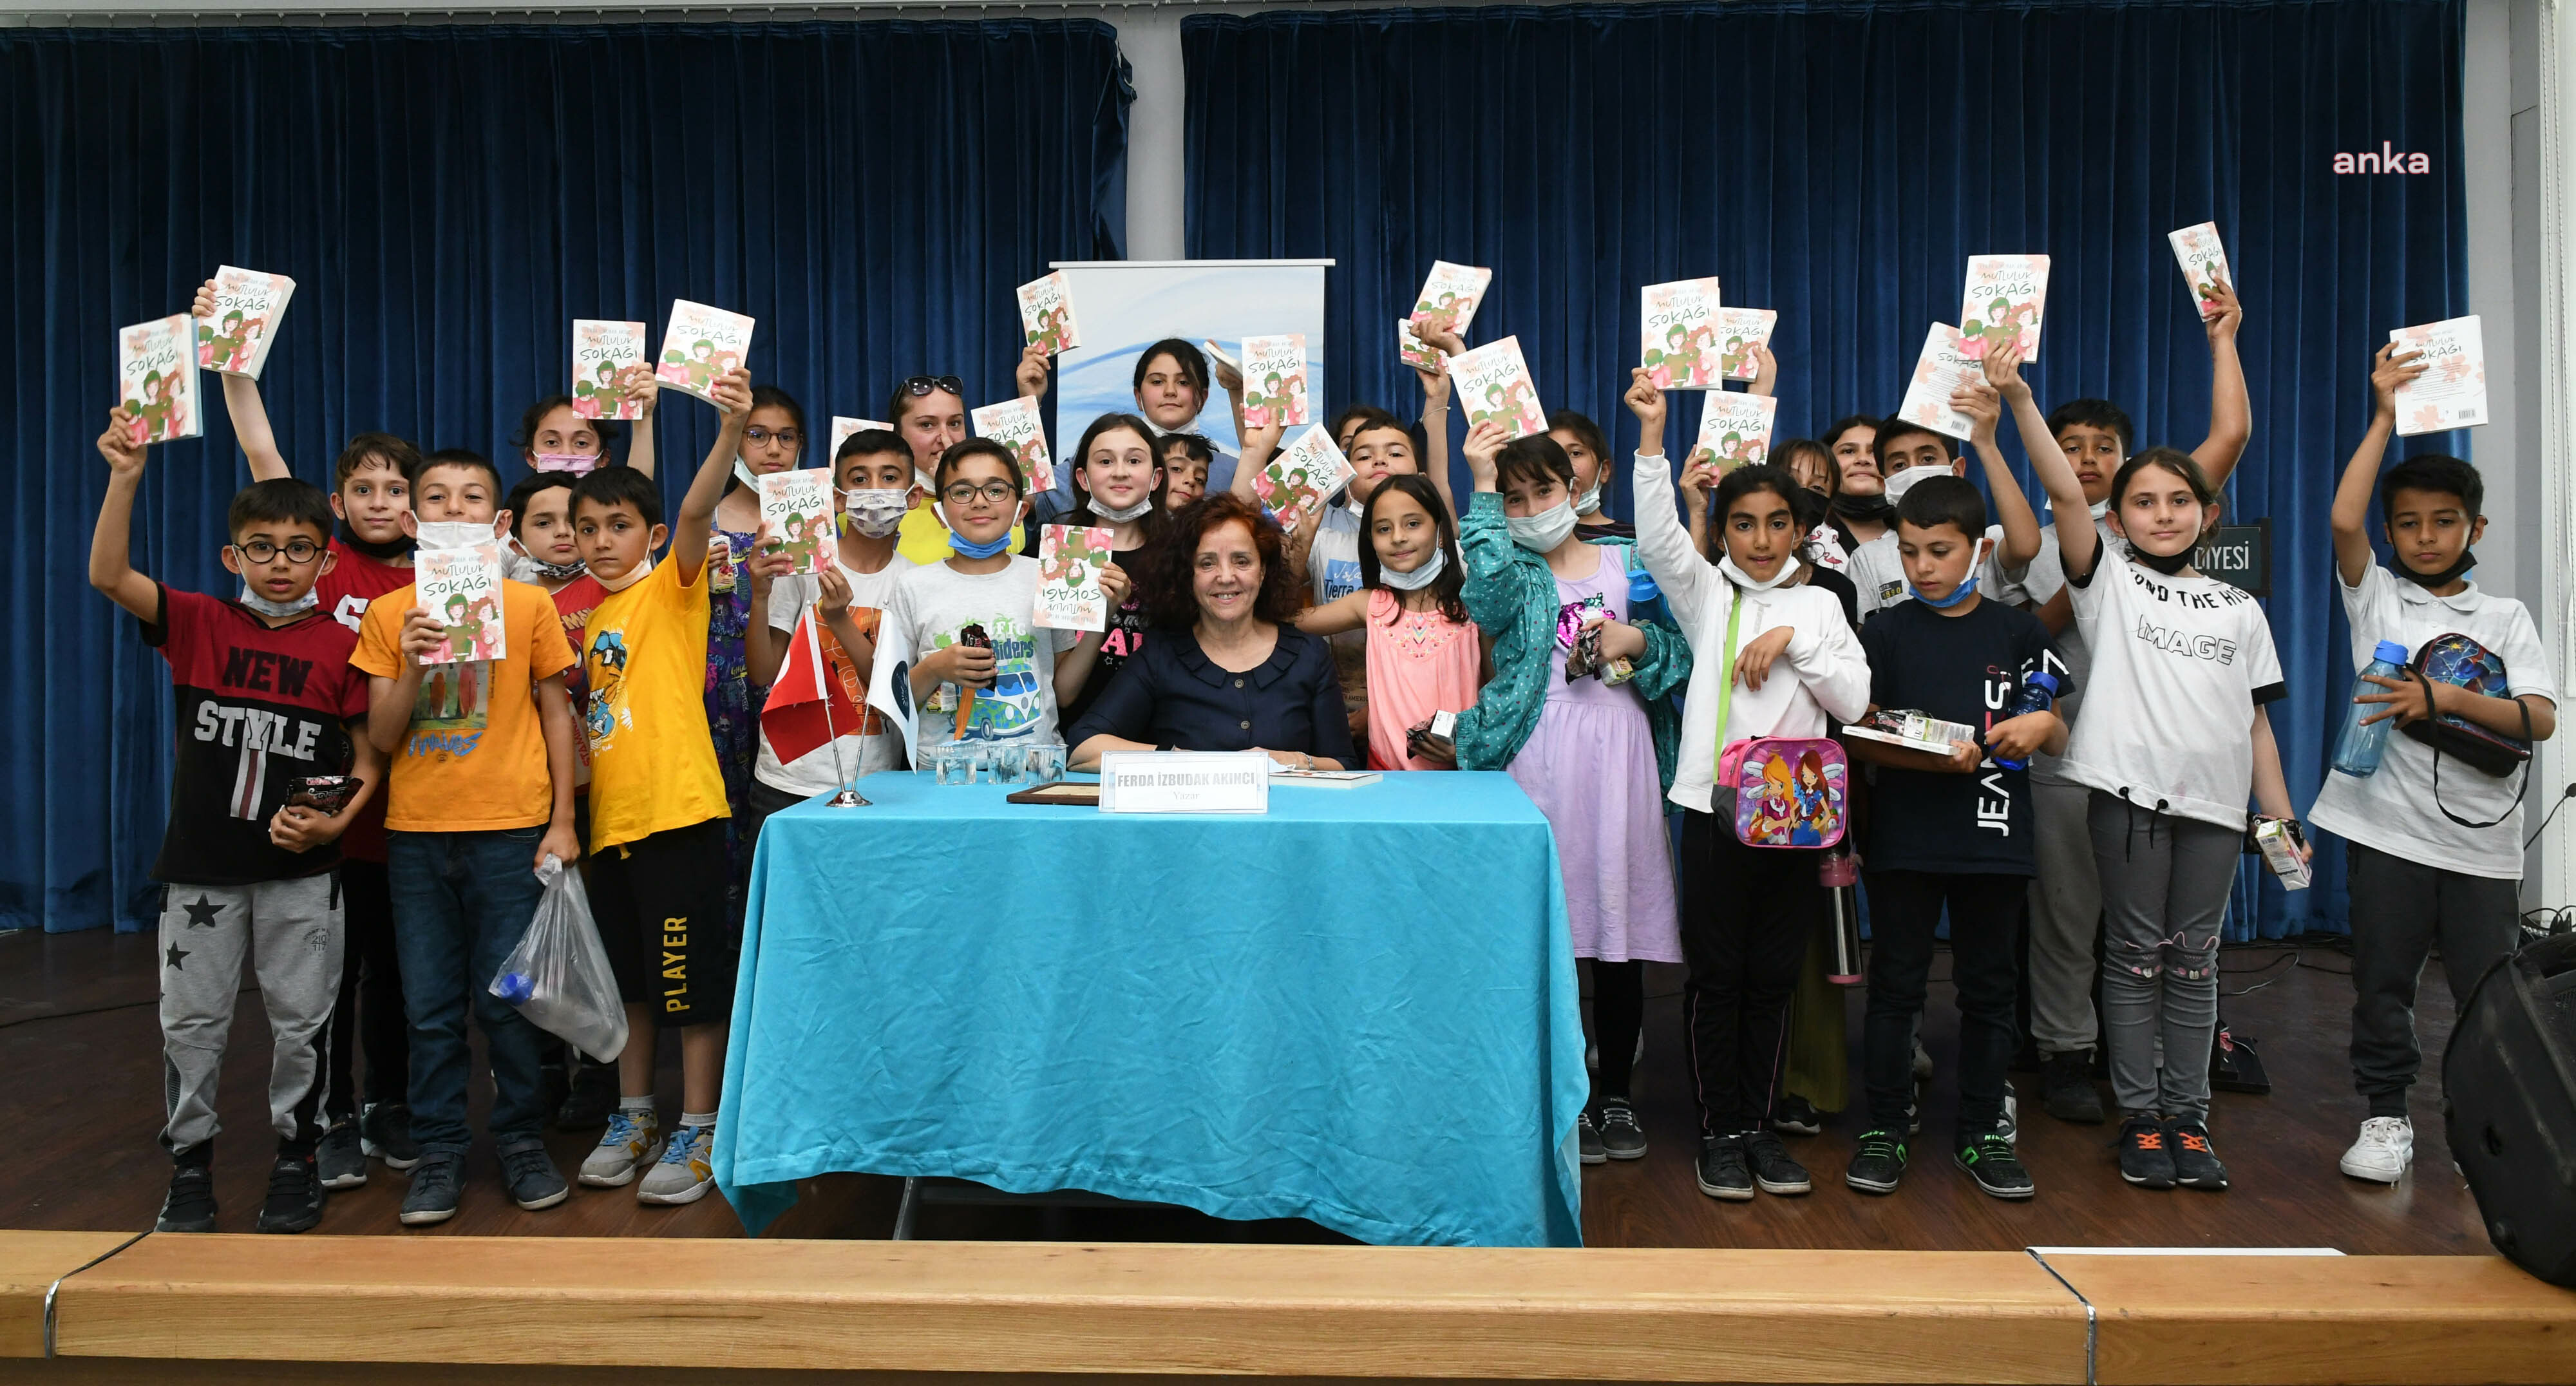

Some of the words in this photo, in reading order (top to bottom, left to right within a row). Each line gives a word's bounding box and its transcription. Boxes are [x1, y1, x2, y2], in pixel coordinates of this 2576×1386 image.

[1981, 270, 2035, 281] MUTLULUK
[1972, 281, 2036, 299] SOKAĞI
[1025, 292, 1061, 316] SOKAĞI
[1656, 295, 1707, 308] MUTLULUK
[1649, 304, 1710, 328] SOKAĞI
[587, 335, 634, 346] MUTLULUK
[677, 325, 741, 346] SOKAĞI
[126, 346, 178, 375] SOKAĞI
[580, 346, 638, 361] SOKAĞI
[1253, 347, 1295, 358] MUTLULUK
[1248, 356, 1300, 374] SOKAĞI
[1466, 354, 1510, 374] MUTLULUK
[1463, 362, 1520, 392] SOKAĞI
[987, 412, 1028, 428] MUTLULUK
[1716, 406, 1763, 417] MUTLULUK
[1707, 418, 1765, 433] SOKAĞI
[1294, 446, 1331, 490] SOKAĞI
[1307, 442, 1336, 478] MUTLULUK
[773, 484, 818, 497] MUTLULUK
[766, 493, 824, 516] SOKAĞI
[431, 564, 485, 576] MUTLULUK
[424, 573, 491, 596] SOKAĞI
[2130, 568, 2169, 602] OND
[2176, 590, 2219, 609] THE
[1043, 587, 1101, 602] SOKAĞI
[1046, 602, 1093, 614] MUTLULUK
[2137, 614, 2237, 666] IMAGE
[222, 646, 313, 698] NEW
[194, 699, 322, 761] STYLE
[1117, 774, 1155, 787] FERDA
[1157, 772, 1210, 786] İZBUDAK
[1212, 772, 1255, 785] AKINCI
[1173, 791, 1201, 801] Yazar
[663, 917, 690, 1012] PLAYER
